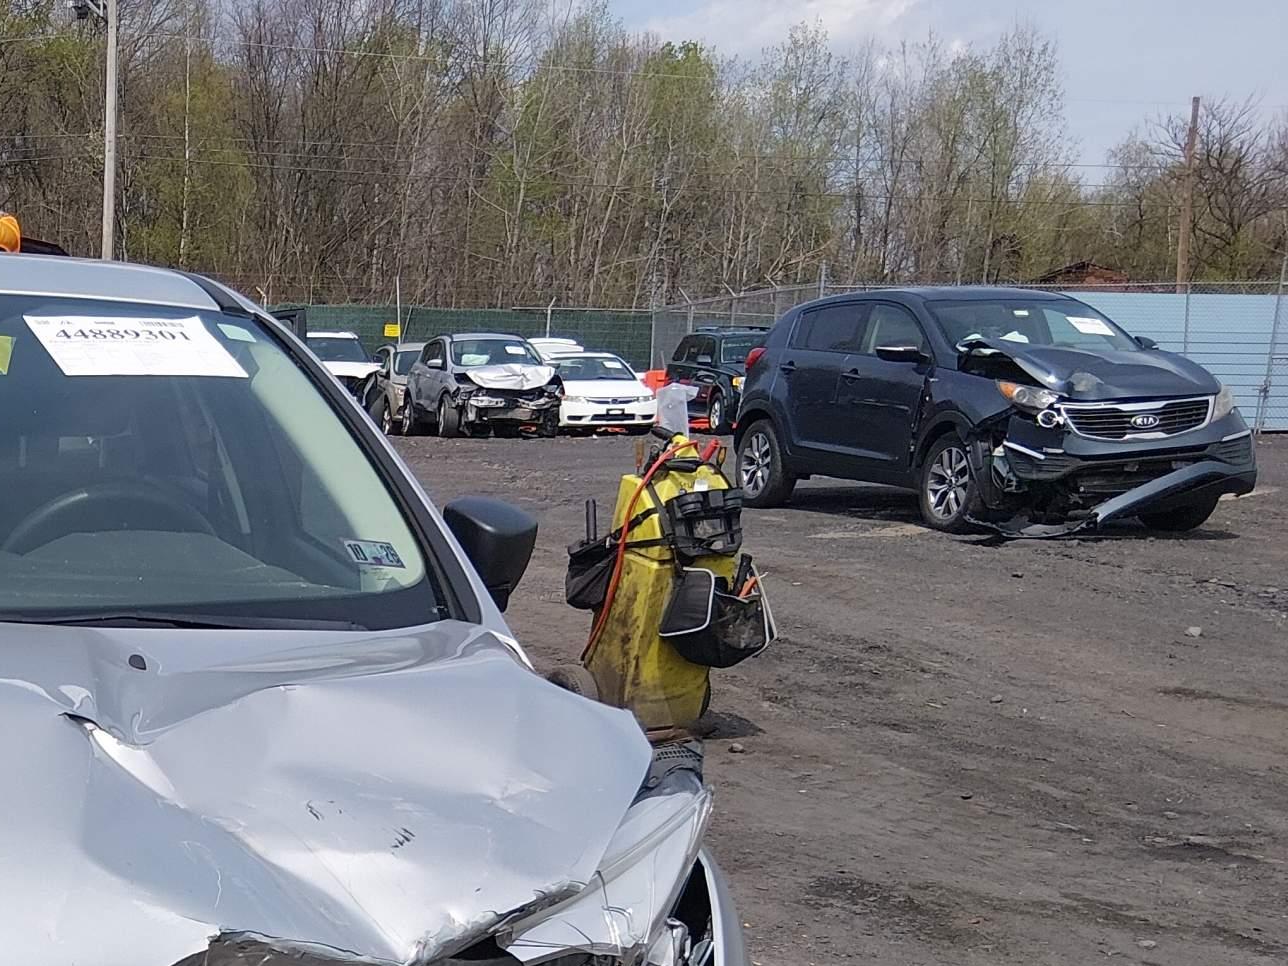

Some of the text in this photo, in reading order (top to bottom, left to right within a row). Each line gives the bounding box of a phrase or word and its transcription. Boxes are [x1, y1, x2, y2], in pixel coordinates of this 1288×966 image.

[55, 328, 191, 341] 44889301
[1135, 416, 1155, 426] KIA
[347, 543, 368, 562] 10
